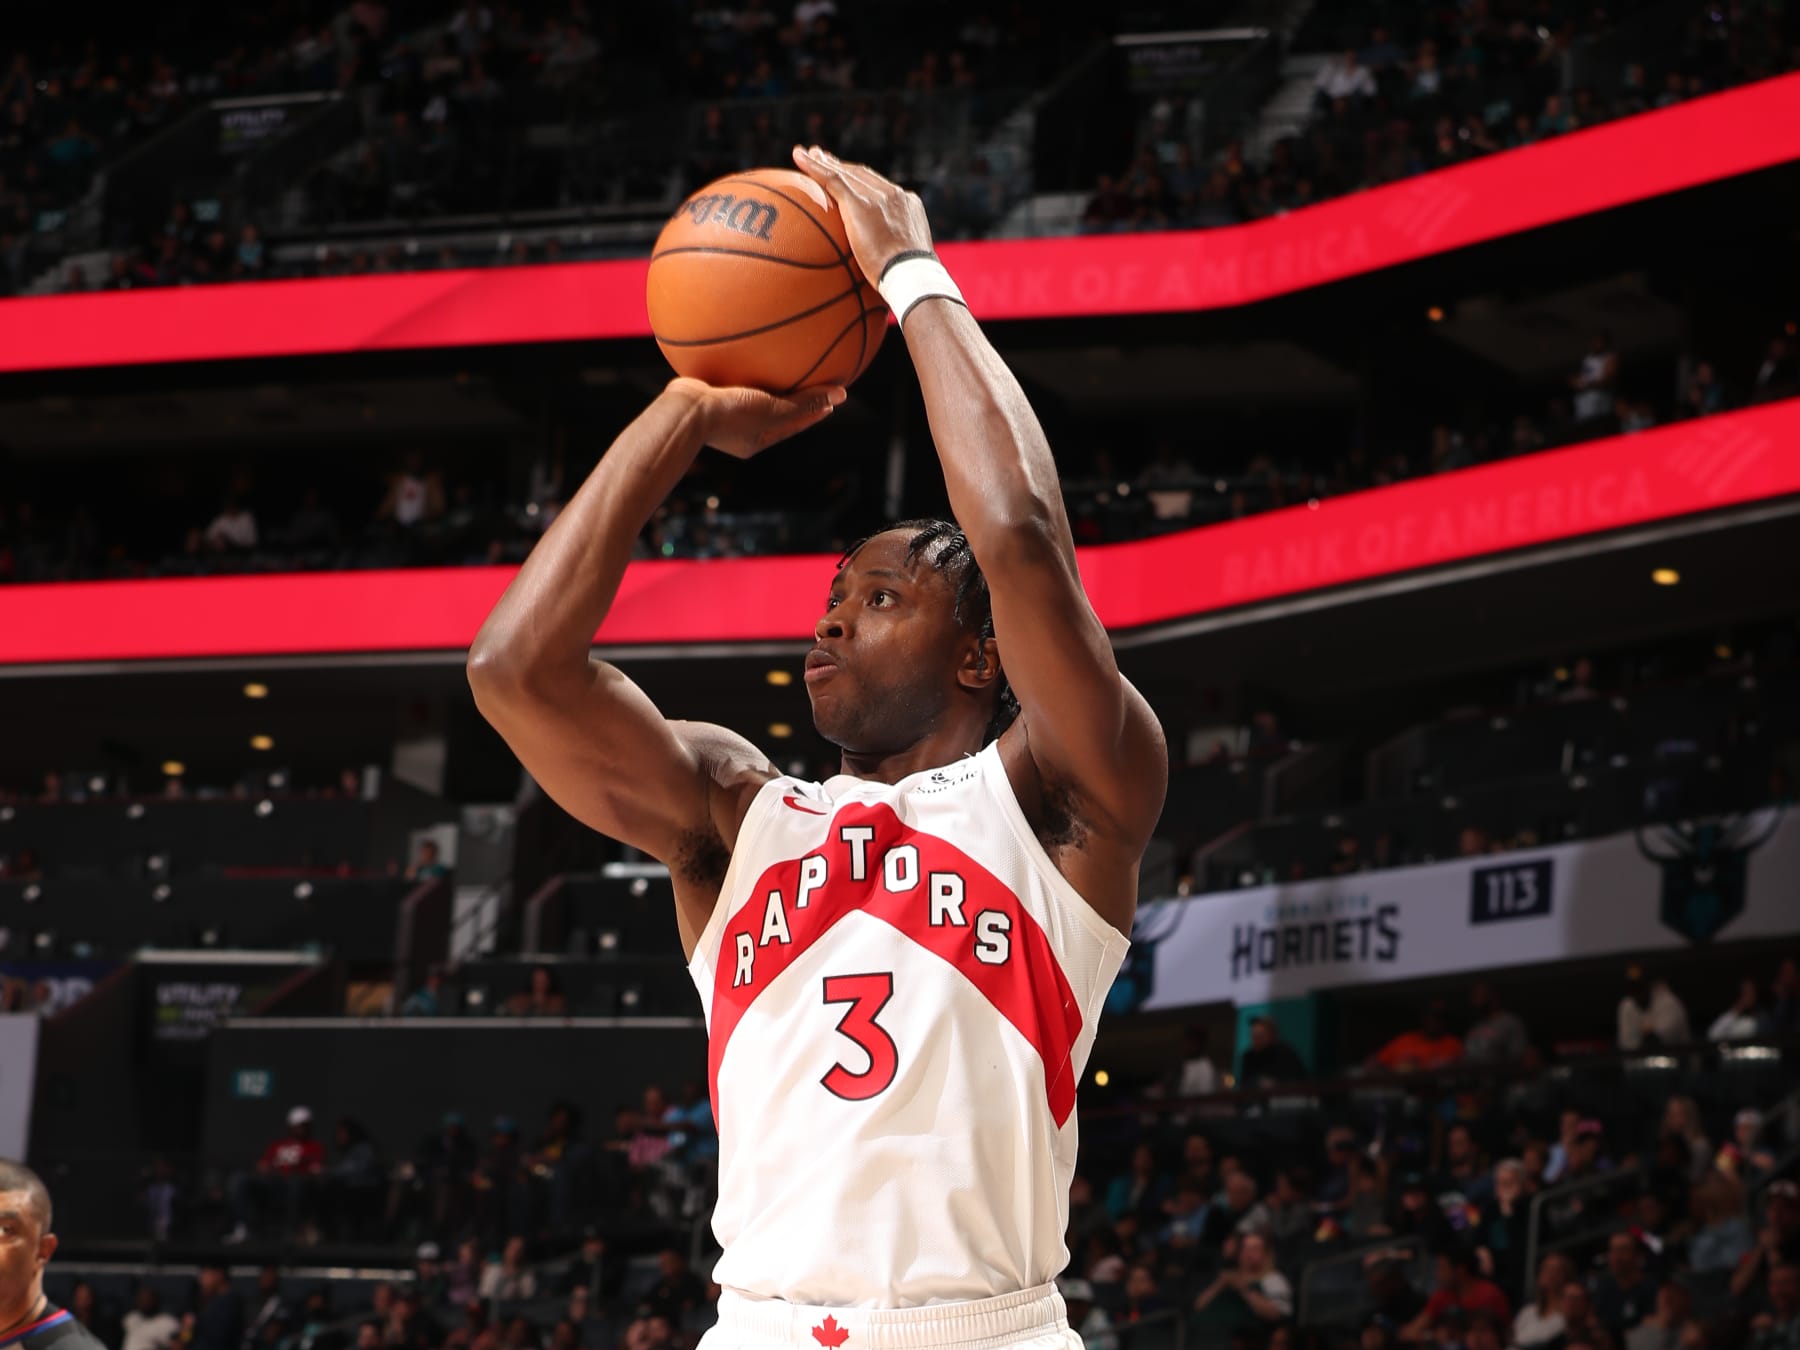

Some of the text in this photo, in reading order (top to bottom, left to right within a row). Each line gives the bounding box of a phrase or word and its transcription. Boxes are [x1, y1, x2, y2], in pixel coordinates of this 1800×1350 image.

[974, 223, 1371, 307] NK OF AMERICA
[1221, 466, 1654, 596] BANK OF AMERICA
[732, 826, 1011, 989] RAPTORS
[1232, 903, 1402, 982] HORNETS
[1486, 869, 1539, 914] 113
[820, 971, 899, 1101] 3
